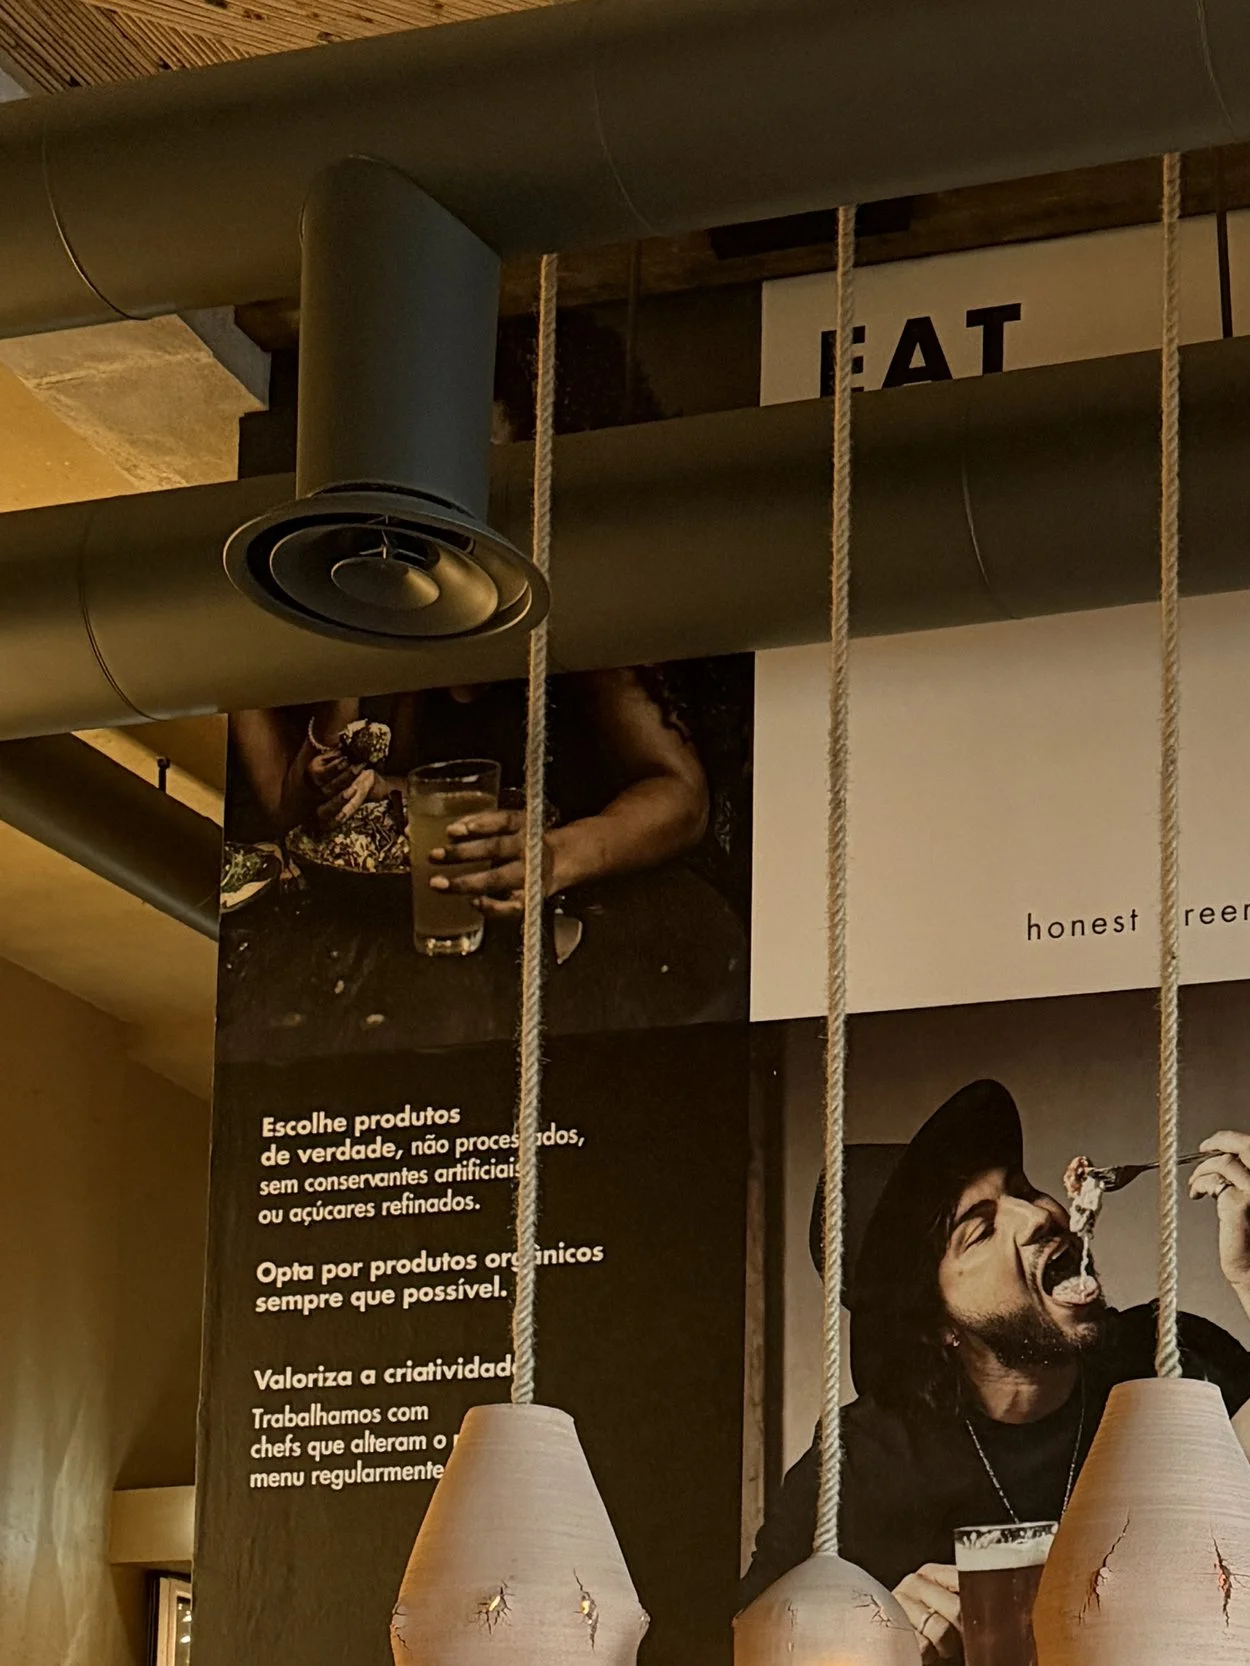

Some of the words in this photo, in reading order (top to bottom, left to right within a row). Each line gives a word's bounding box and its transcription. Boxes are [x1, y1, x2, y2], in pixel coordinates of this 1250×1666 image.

[820, 303, 1021, 397] EAT
[1027, 908, 1139, 941] honest
[262, 1111, 348, 1138] Escolhe
[354, 1104, 461, 1137] produtos
[260, 1143, 291, 1167] de
[297, 1136, 404, 1164] verdade,
[411, 1134, 450, 1156] não
[259, 1178, 299, 1196] sem
[304, 1167, 429, 1193] conservantes
[258, 1209, 284, 1225] ou
[289, 1200, 376, 1226] açúcares
[381, 1188, 481, 1216] refinados.
[256, 1261, 314, 1288] Opta
[321, 1262, 364, 1286] por
[369, 1249, 478, 1281] produtos
[255, 1292, 344, 1316] sempre
[350, 1288, 396, 1312] que
[402, 1274, 508, 1310] possível.
[253, 1365, 353, 1390] Valoriza
[360, 1369, 376, 1385] a
[383, 1354, 515, 1384] criatividad
[251, 1402, 382, 1430] Trabalhamos
[387, 1405, 429, 1423] com
[250, 1433, 302, 1459] chefs
[307, 1439, 345, 1462] que
[350, 1429, 427, 1454] alteram
[432, 1434, 447, 1450] o
[249, 1471, 305, 1488] menu
